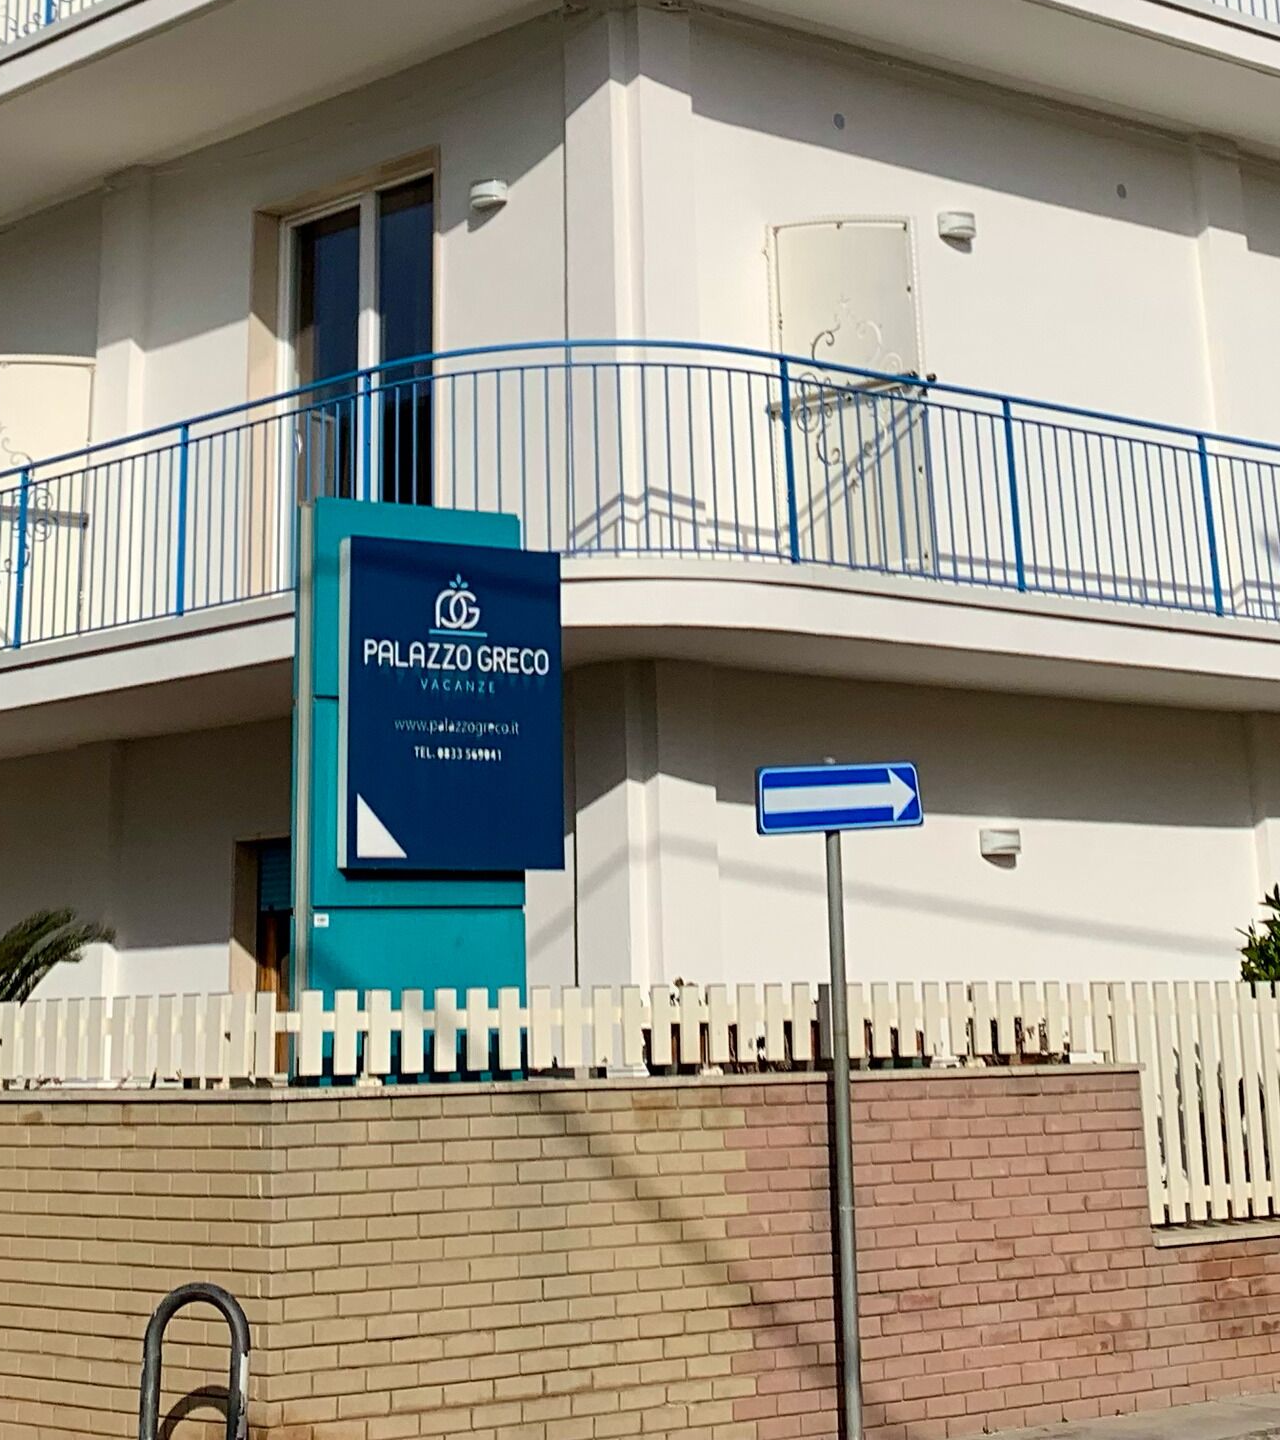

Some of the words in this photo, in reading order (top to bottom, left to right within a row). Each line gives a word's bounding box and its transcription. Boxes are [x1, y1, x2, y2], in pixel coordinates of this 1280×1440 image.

[363, 638, 472, 671] PALAZZO
[477, 645, 550, 676] GRECO
[420, 678, 495, 694] VACANZE
[394, 717, 519, 737] www.palazzogreco.it
